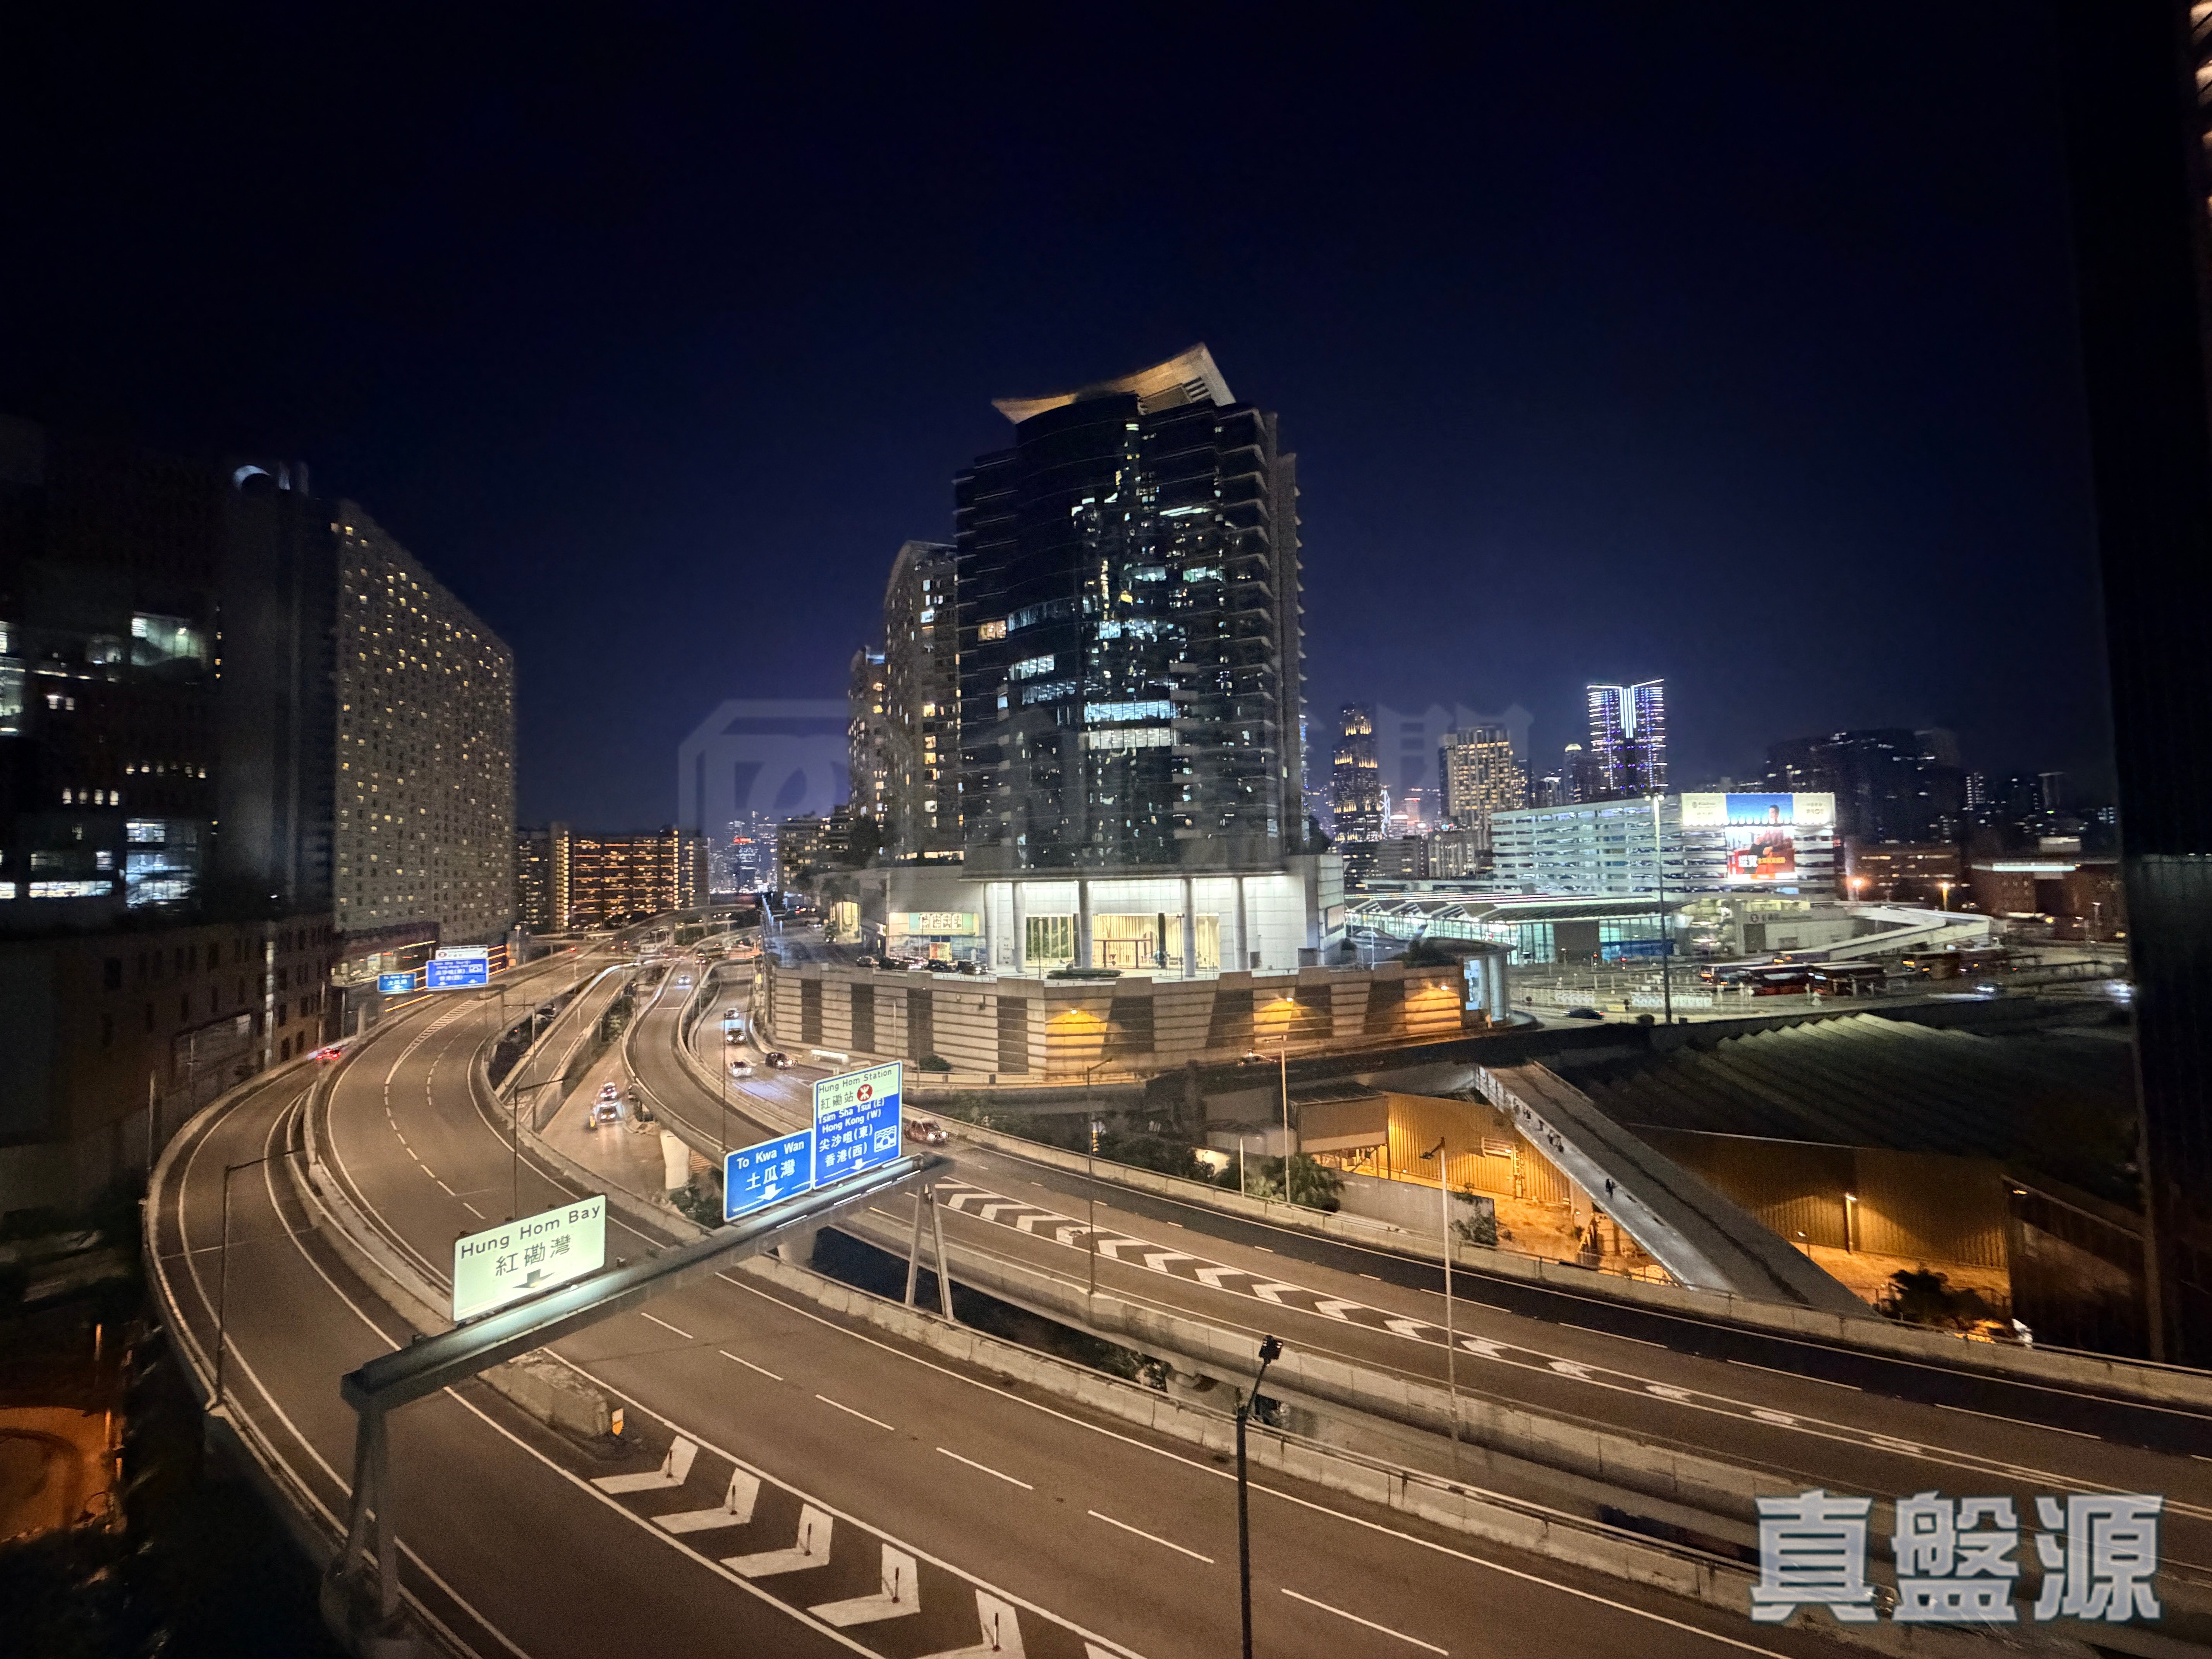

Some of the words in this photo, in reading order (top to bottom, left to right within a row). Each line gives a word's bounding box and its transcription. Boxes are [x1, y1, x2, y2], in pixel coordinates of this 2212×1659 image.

[819, 1084, 839, 1093] Hung
[843, 1078, 860, 1087] Hom
[864, 1070, 892, 1081] Station
[818, 1114, 836, 1124] Tsim
[838, 1109, 854, 1118] Sha
[857, 1102, 871, 1113] Tsui
[873, 1097, 885, 1108] (E)
[821, 1091, 854, 1110] 紅磡站
[822, 1122, 843, 1134] Hong
[845, 1116, 864, 1127] Kong
[867, 1109, 881, 1121] (W)
[819, 1123, 873, 1152] 尖沙咀(東)
[737, 1157, 750, 1170] To
[756, 1149, 777, 1164] Kwa
[784, 1141, 804, 1154] Wan
[825, 1142, 867, 1167] 香港(西)
[745, 1158, 795, 1191] 土瓜灣
[461, 1235, 510, 1259] Hung
[520, 1219, 560, 1240] Hom
[568, 1206, 601, 1224] Bay
[495, 1234, 571, 1277] 紅磡灣
